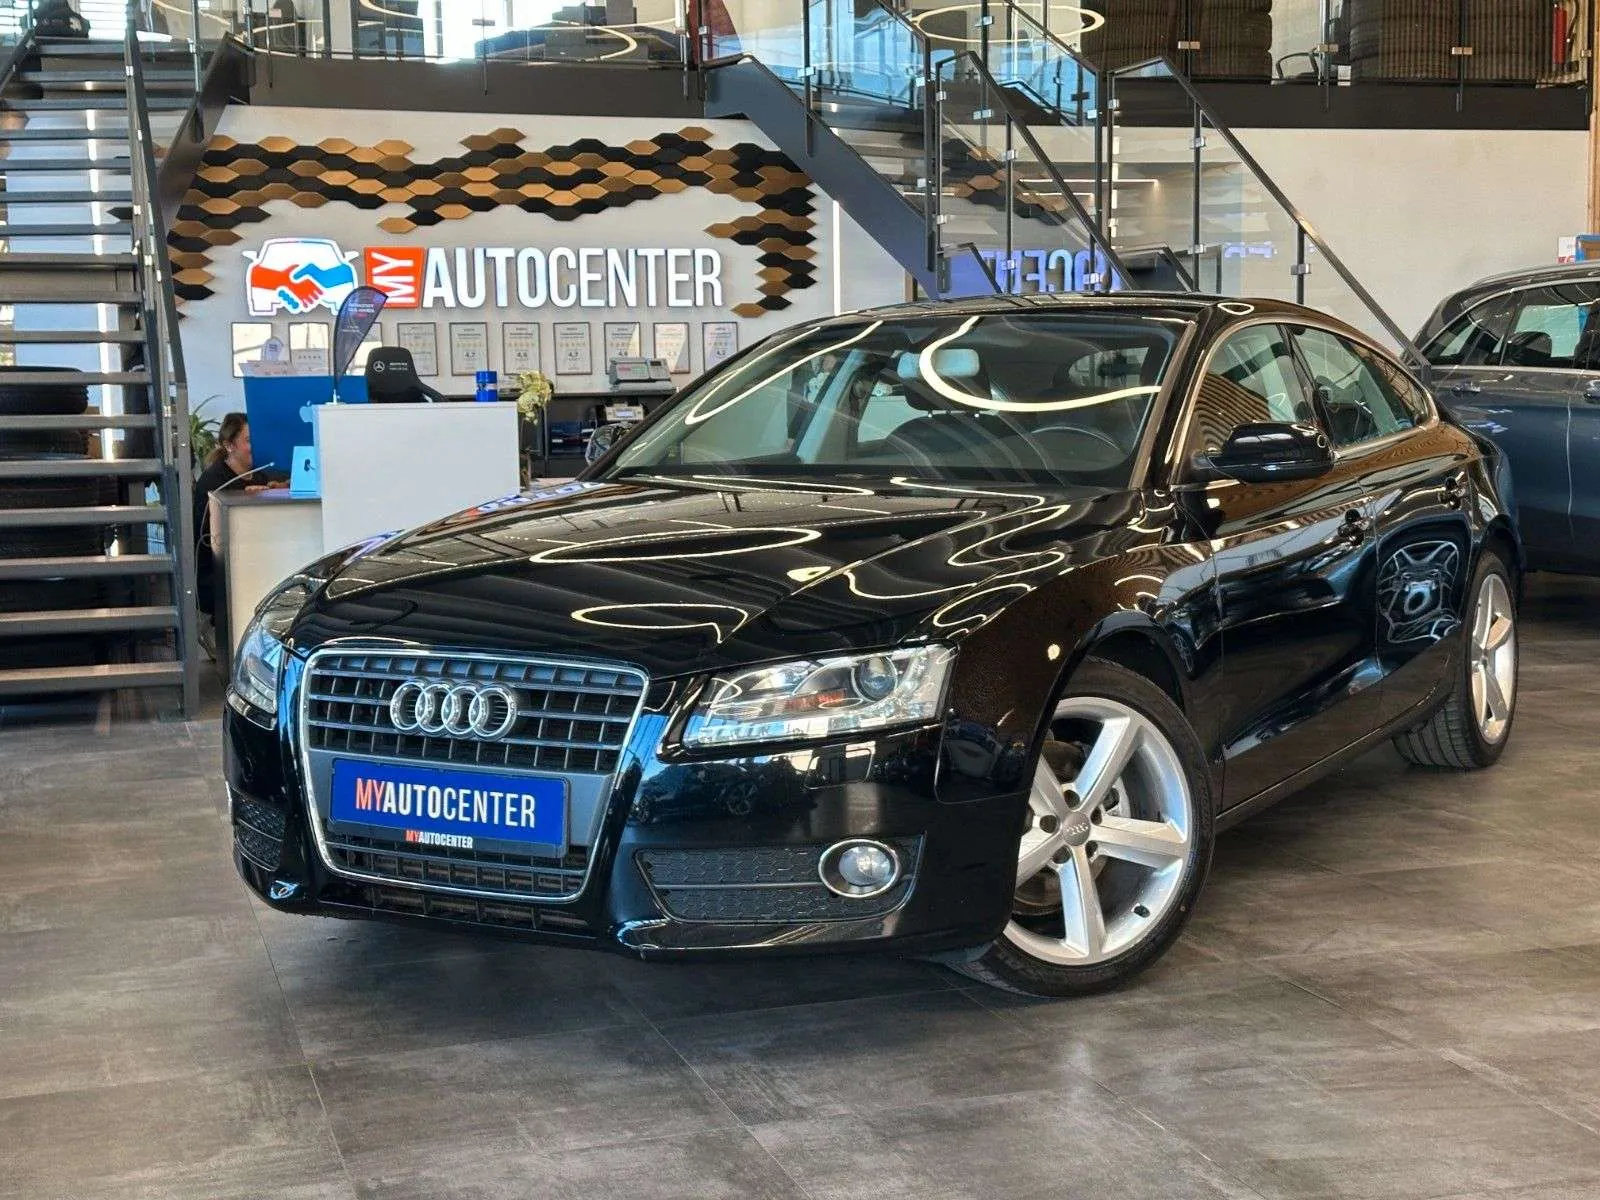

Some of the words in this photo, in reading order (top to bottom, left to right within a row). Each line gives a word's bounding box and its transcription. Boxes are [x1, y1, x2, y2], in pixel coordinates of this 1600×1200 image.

[371, 251, 416, 304] MY
[421, 246, 724, 308] AUTOCENTER
[355, 777, 536, 829] MYAUTOCENTER
[405, 830, 473, 849] MYAUTOCENTER
